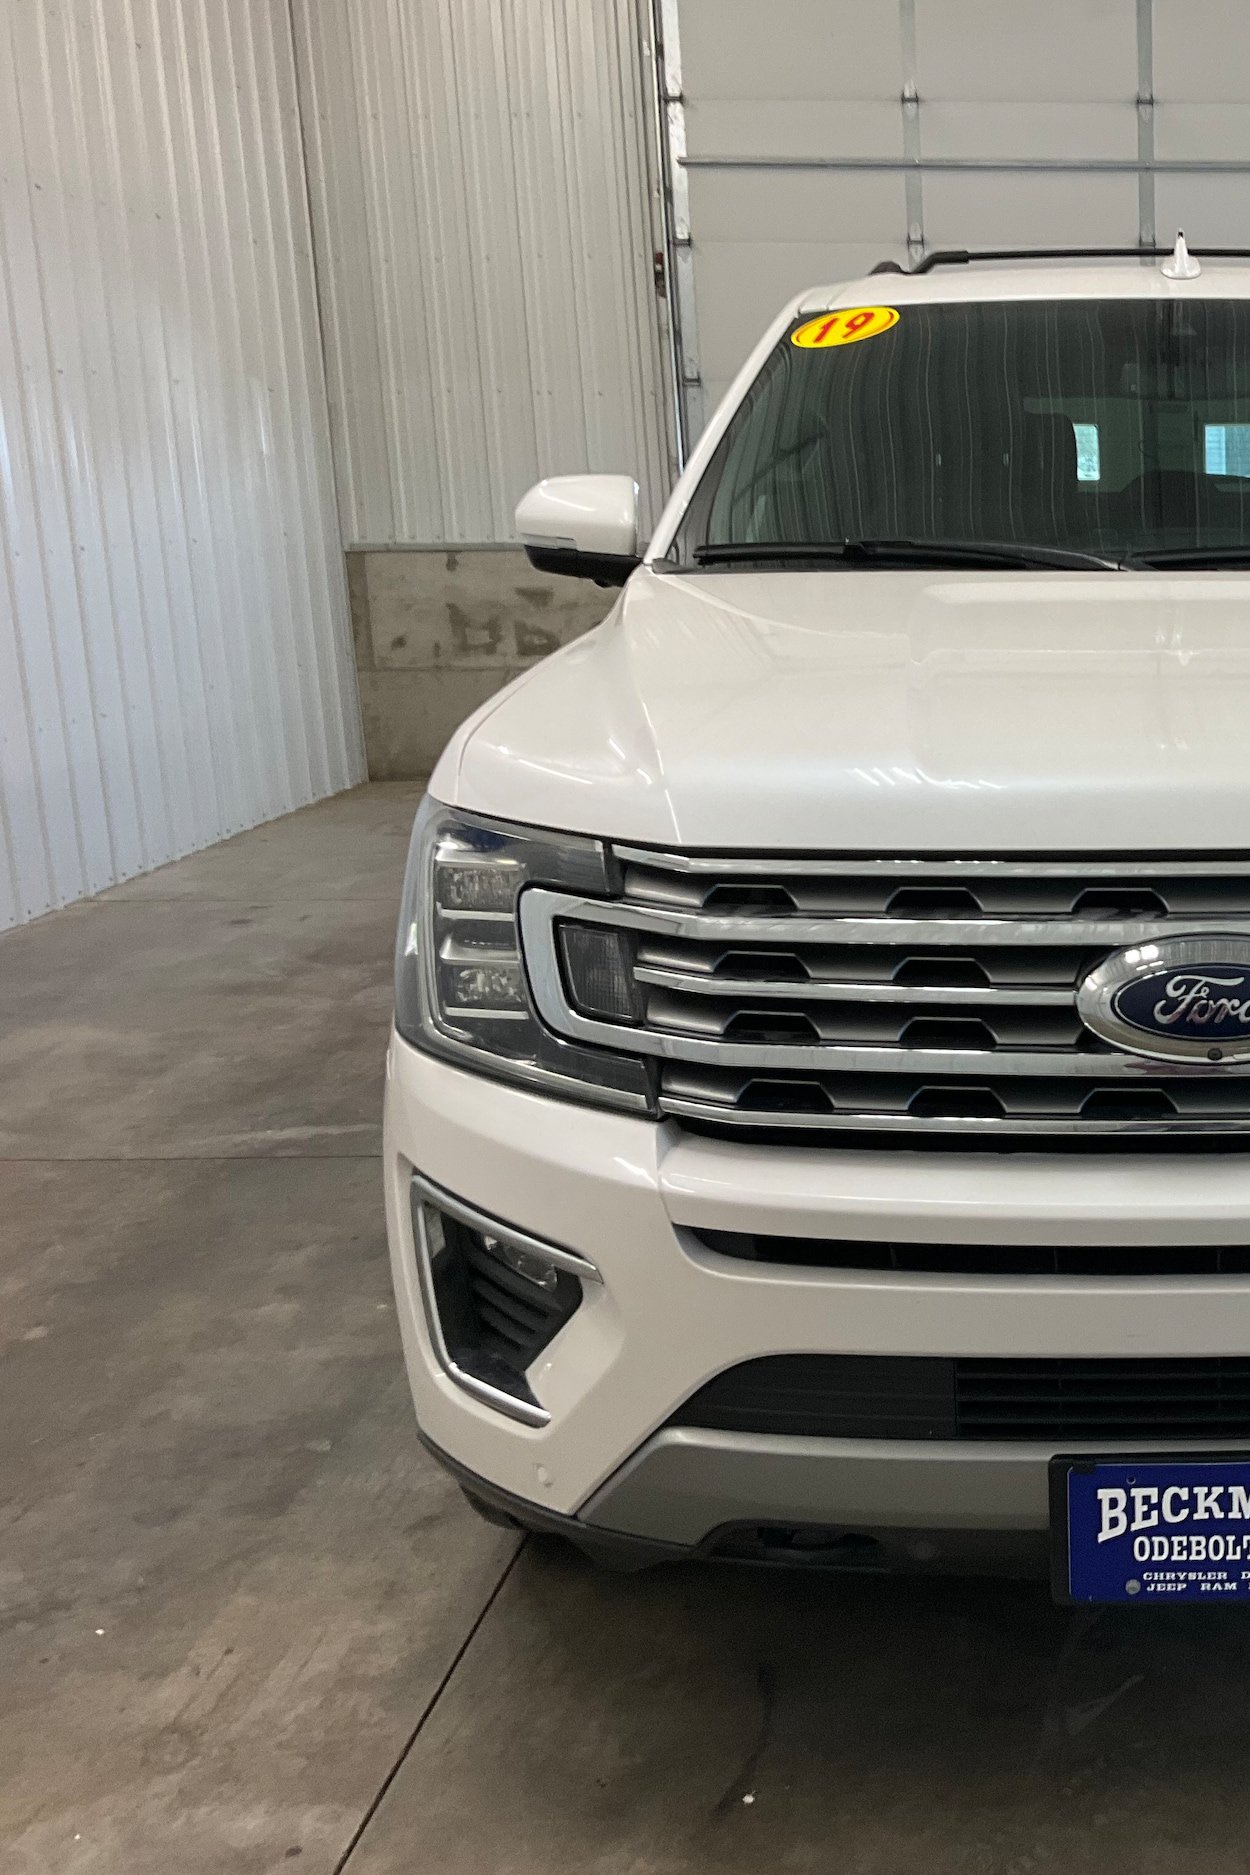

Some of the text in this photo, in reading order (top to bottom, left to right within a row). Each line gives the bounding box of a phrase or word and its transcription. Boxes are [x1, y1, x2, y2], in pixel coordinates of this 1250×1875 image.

[814, 312, 875, 343] 19
[1143, 1571, 1228, 1580] CHRYSLER
[1146, 1582, 1187, 1591] JEEP
[1200, 1582, 1238, 1591] RAM
